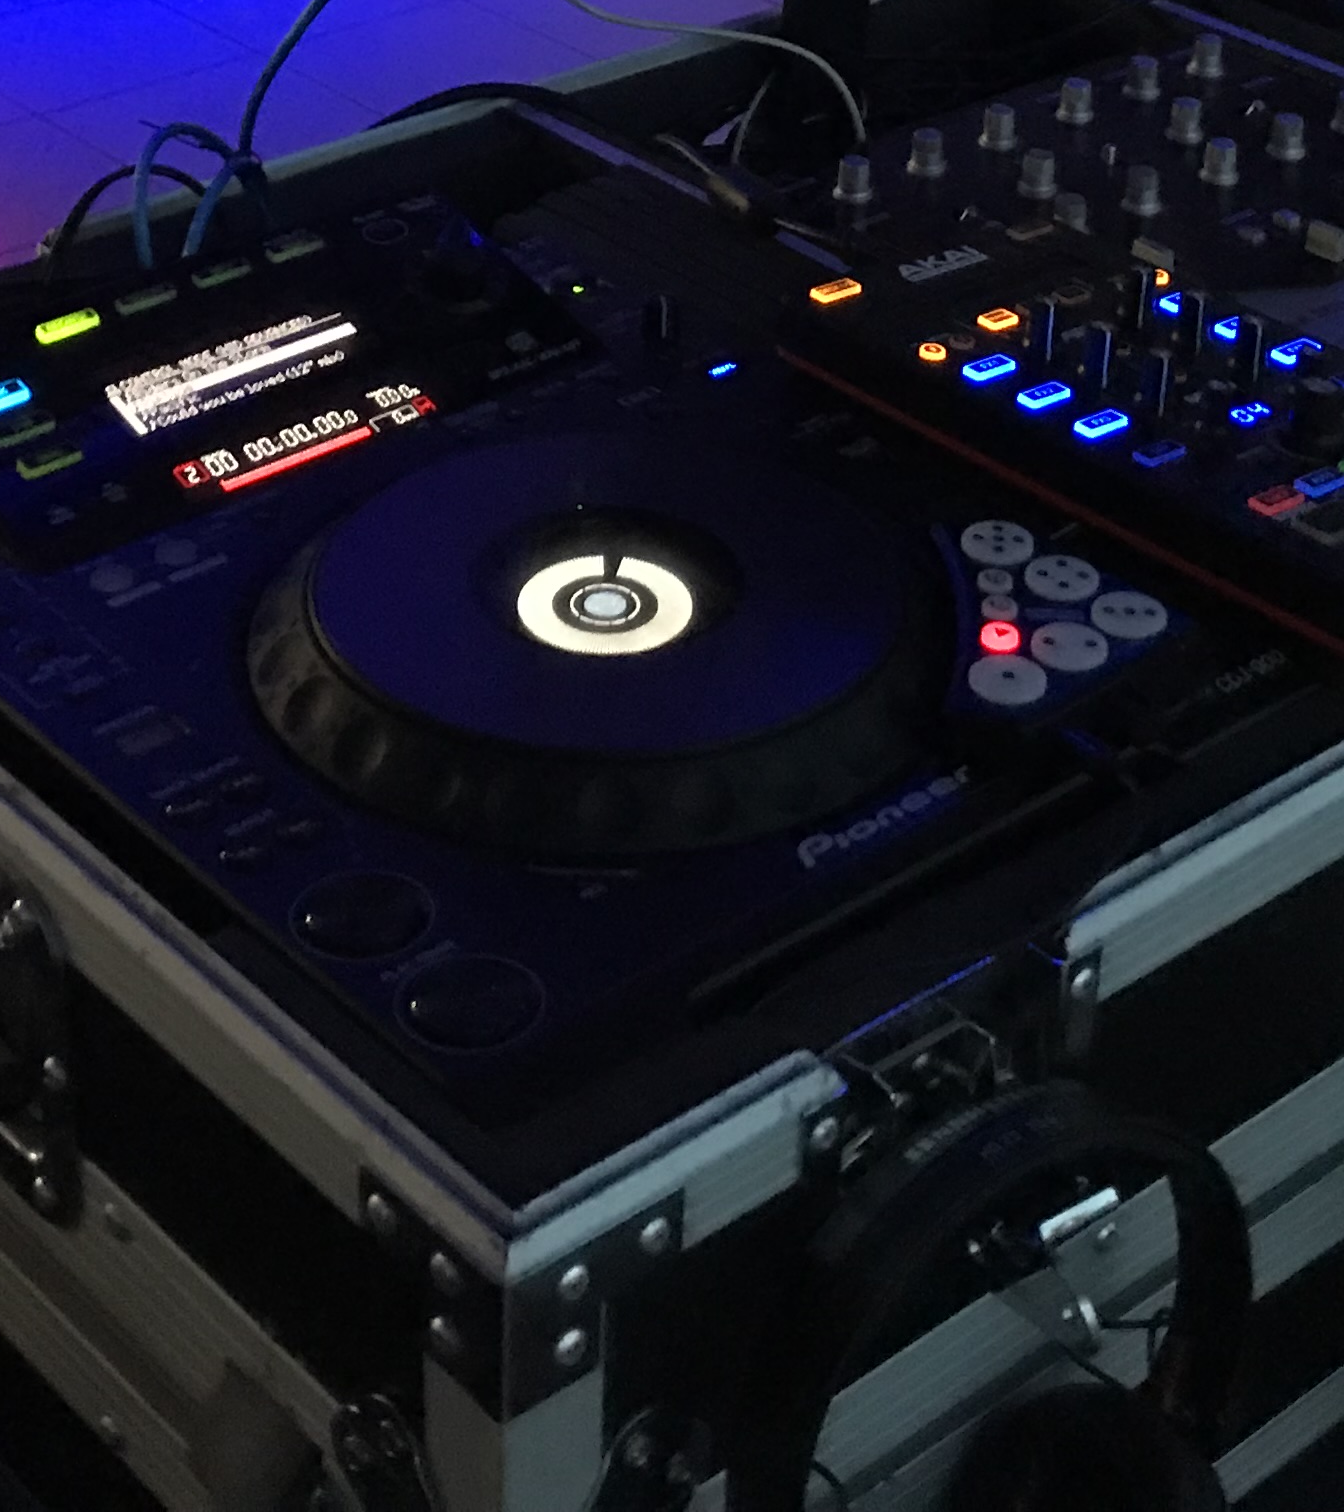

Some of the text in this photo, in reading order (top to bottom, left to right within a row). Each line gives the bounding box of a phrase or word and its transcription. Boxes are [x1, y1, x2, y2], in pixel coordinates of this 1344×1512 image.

[898, 245, 989, 282] AKAI
[184, 466, 200, 484] 2
[797, 764, 969, 870] Pioneer
